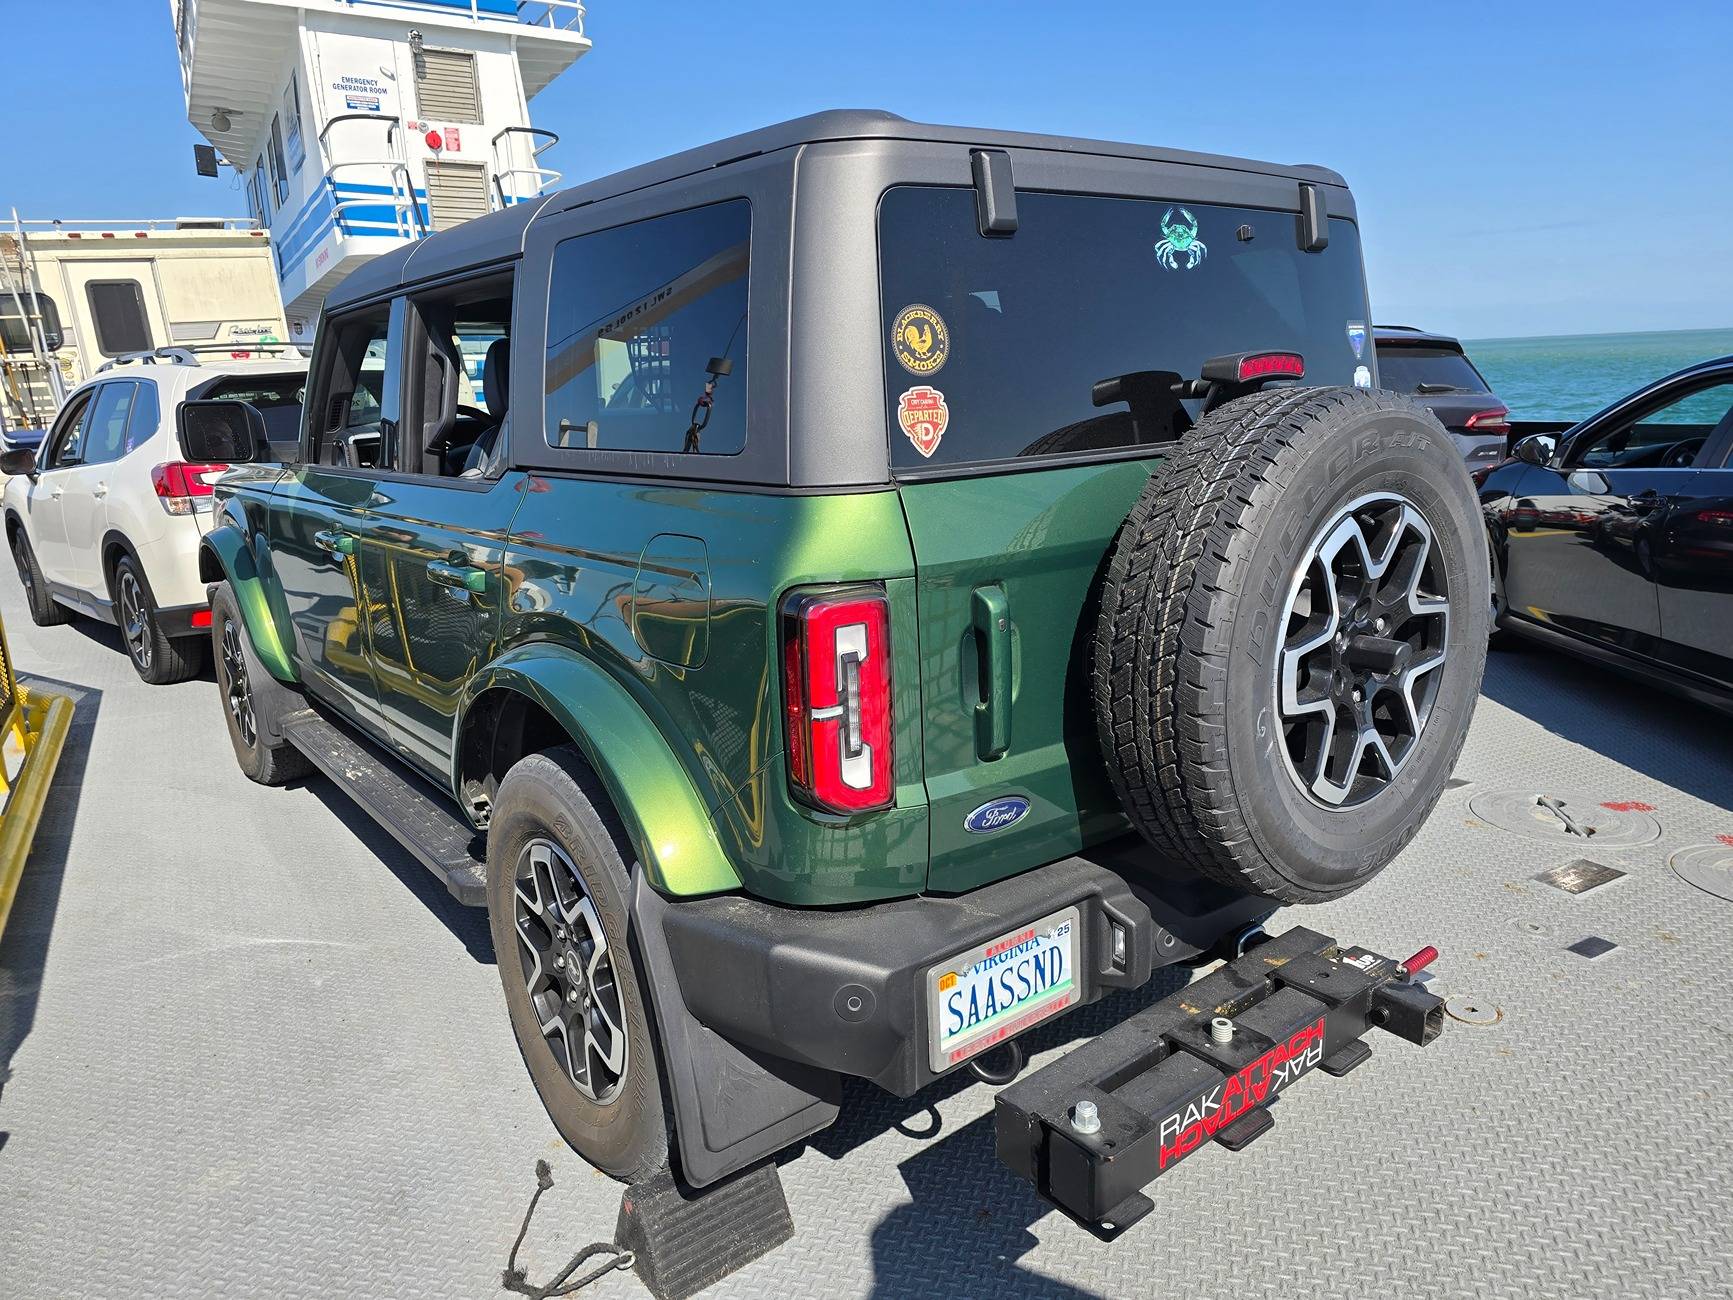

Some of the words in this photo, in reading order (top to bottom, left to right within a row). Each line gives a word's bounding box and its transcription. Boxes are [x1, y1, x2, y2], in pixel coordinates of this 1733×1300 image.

[332, 83, 368, 92] GENERATOR
[341, 76, 378, 86] EMERGENCY
[896, 310, 945, 342] BLACKBERRY
[901, 351, 944, 371] SMOKE
[903, 409, 944, 426] DEPARTED
[982, 805, 1017, 828] Ford
[1057, 923, 1070, 937] 25
[973, 937, 1041, 975] VIRGINIA
[948, 945, 1063, 1037] SAASSND
